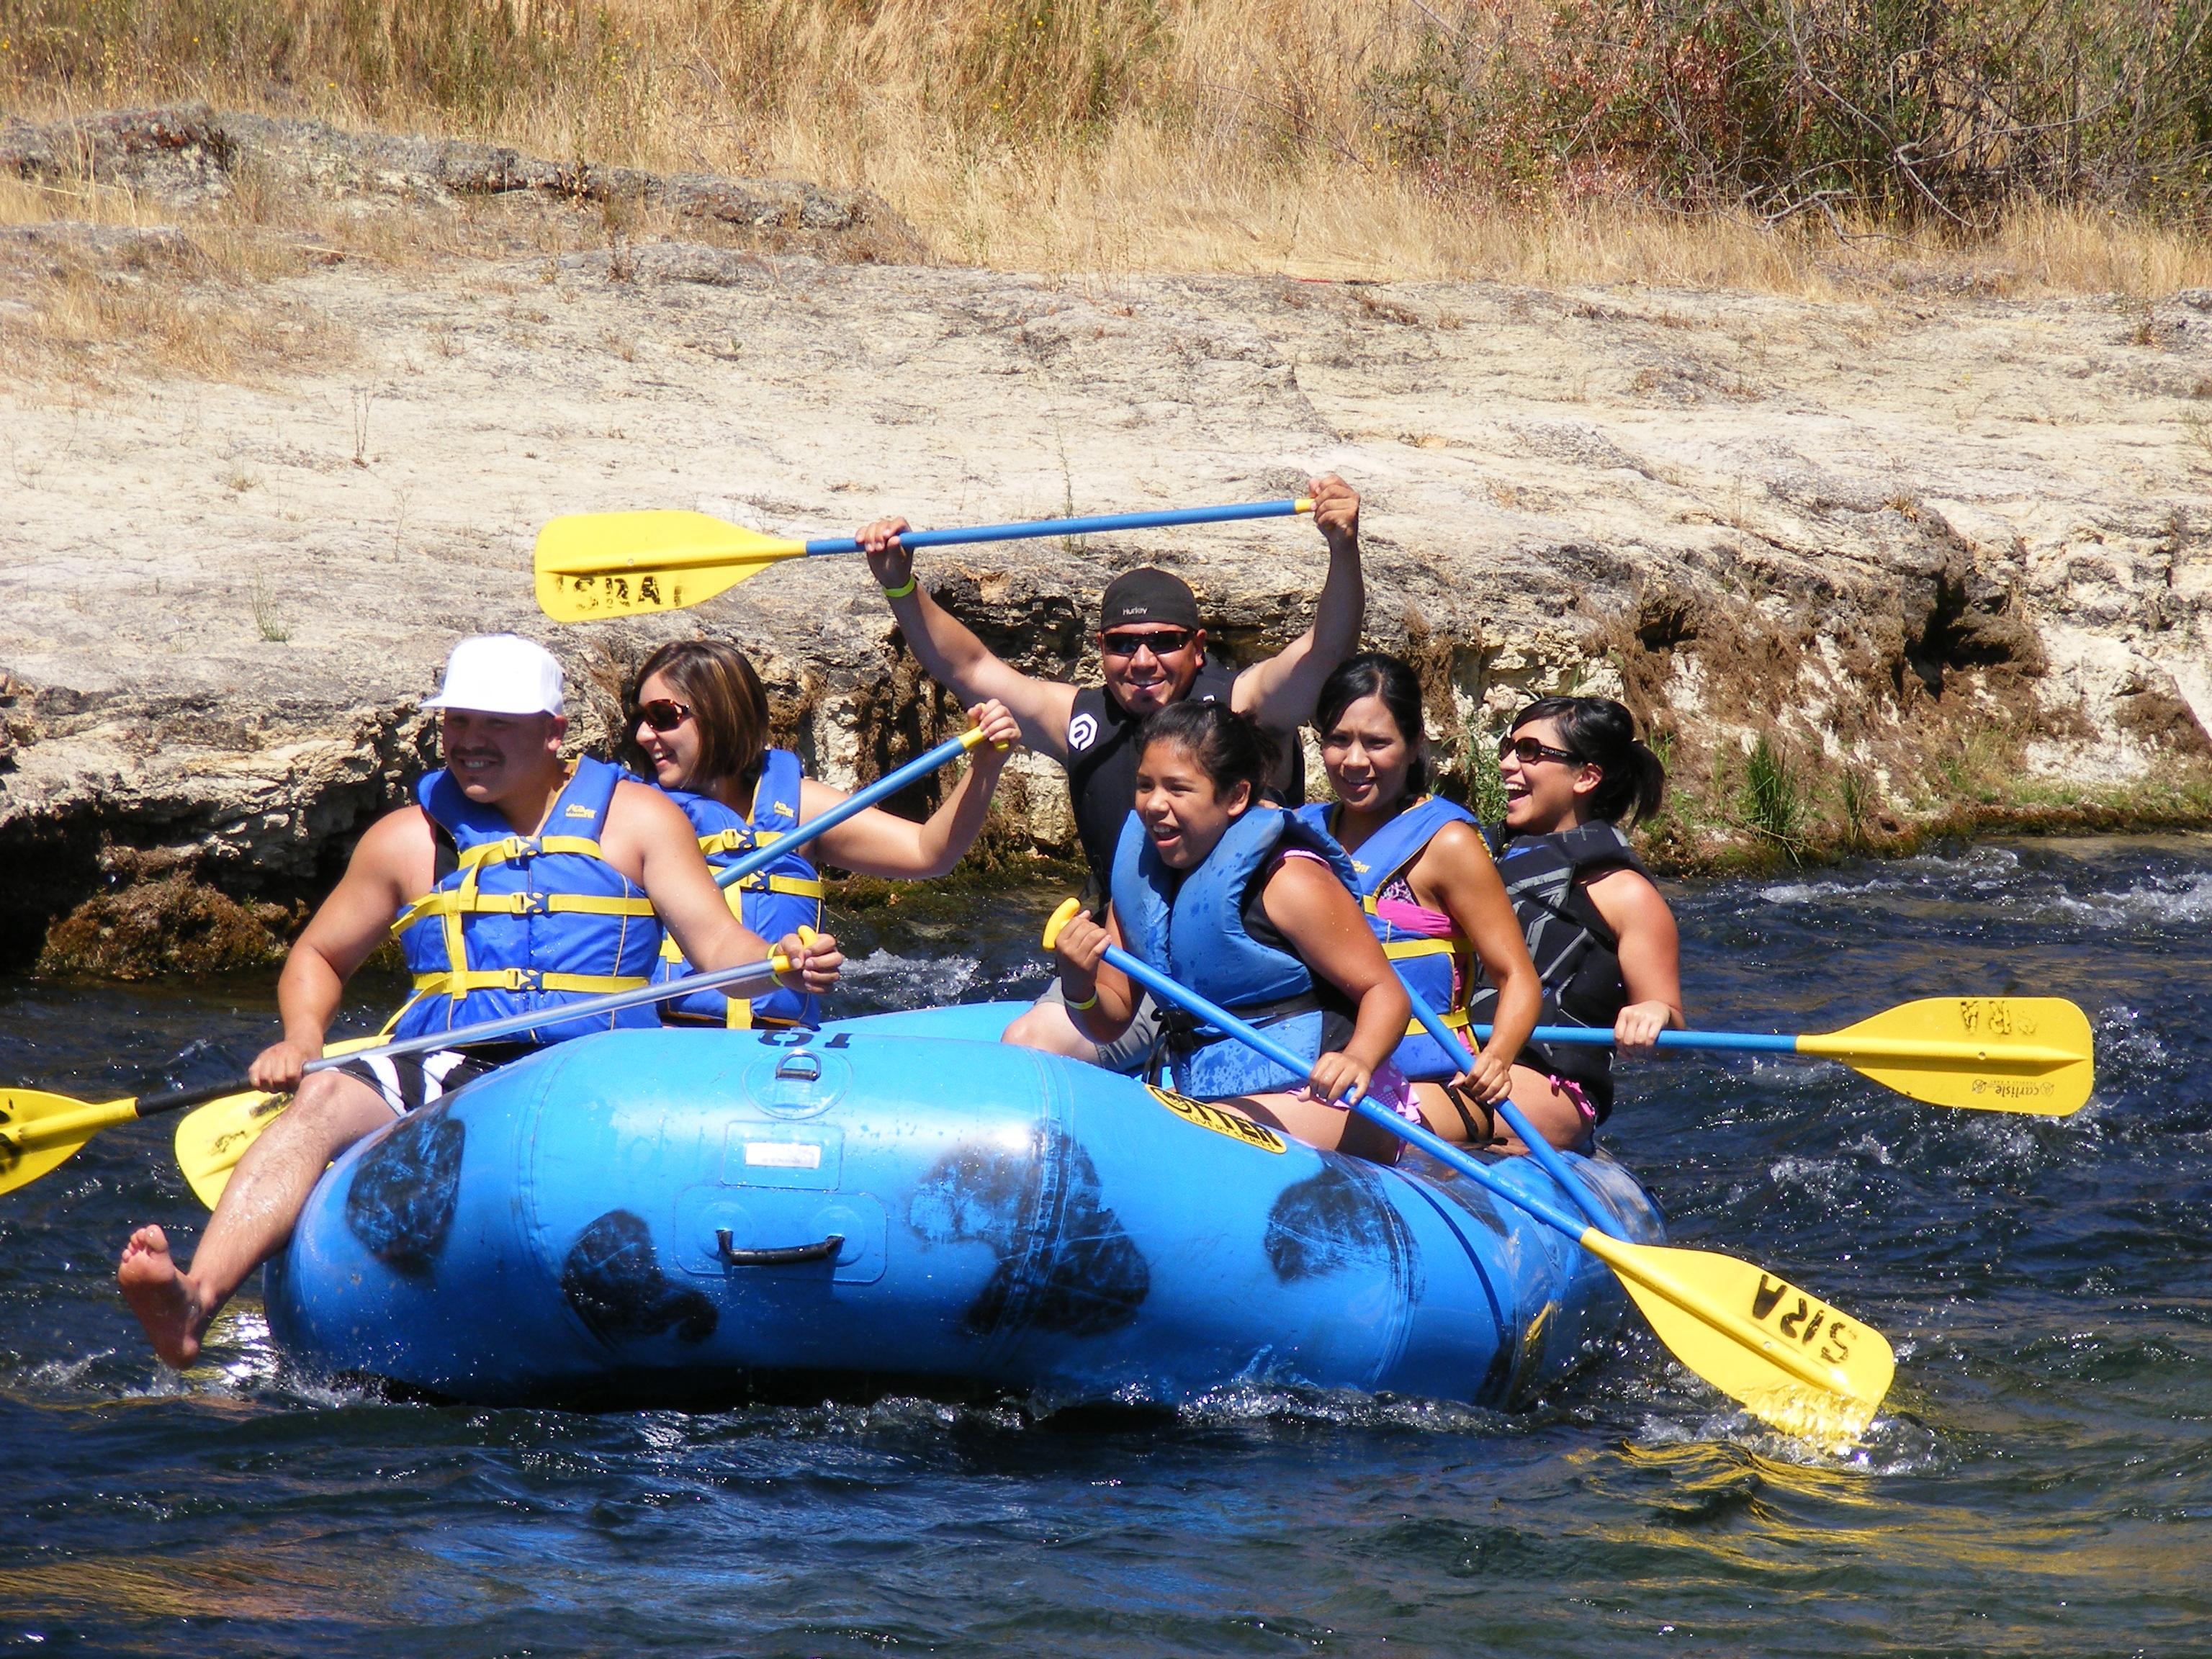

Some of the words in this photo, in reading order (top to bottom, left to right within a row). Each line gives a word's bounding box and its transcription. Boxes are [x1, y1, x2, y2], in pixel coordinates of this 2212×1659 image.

[1123, 606, 1148, 616] Hurley
[1995, 1085, 2039, 1098] carlisle
[1151, 1087, 1282, 1148] OTTER
[1189, 1114, 1229, 1133] LIVERY
[1235, 1131, 1275, 1150] SERIES
